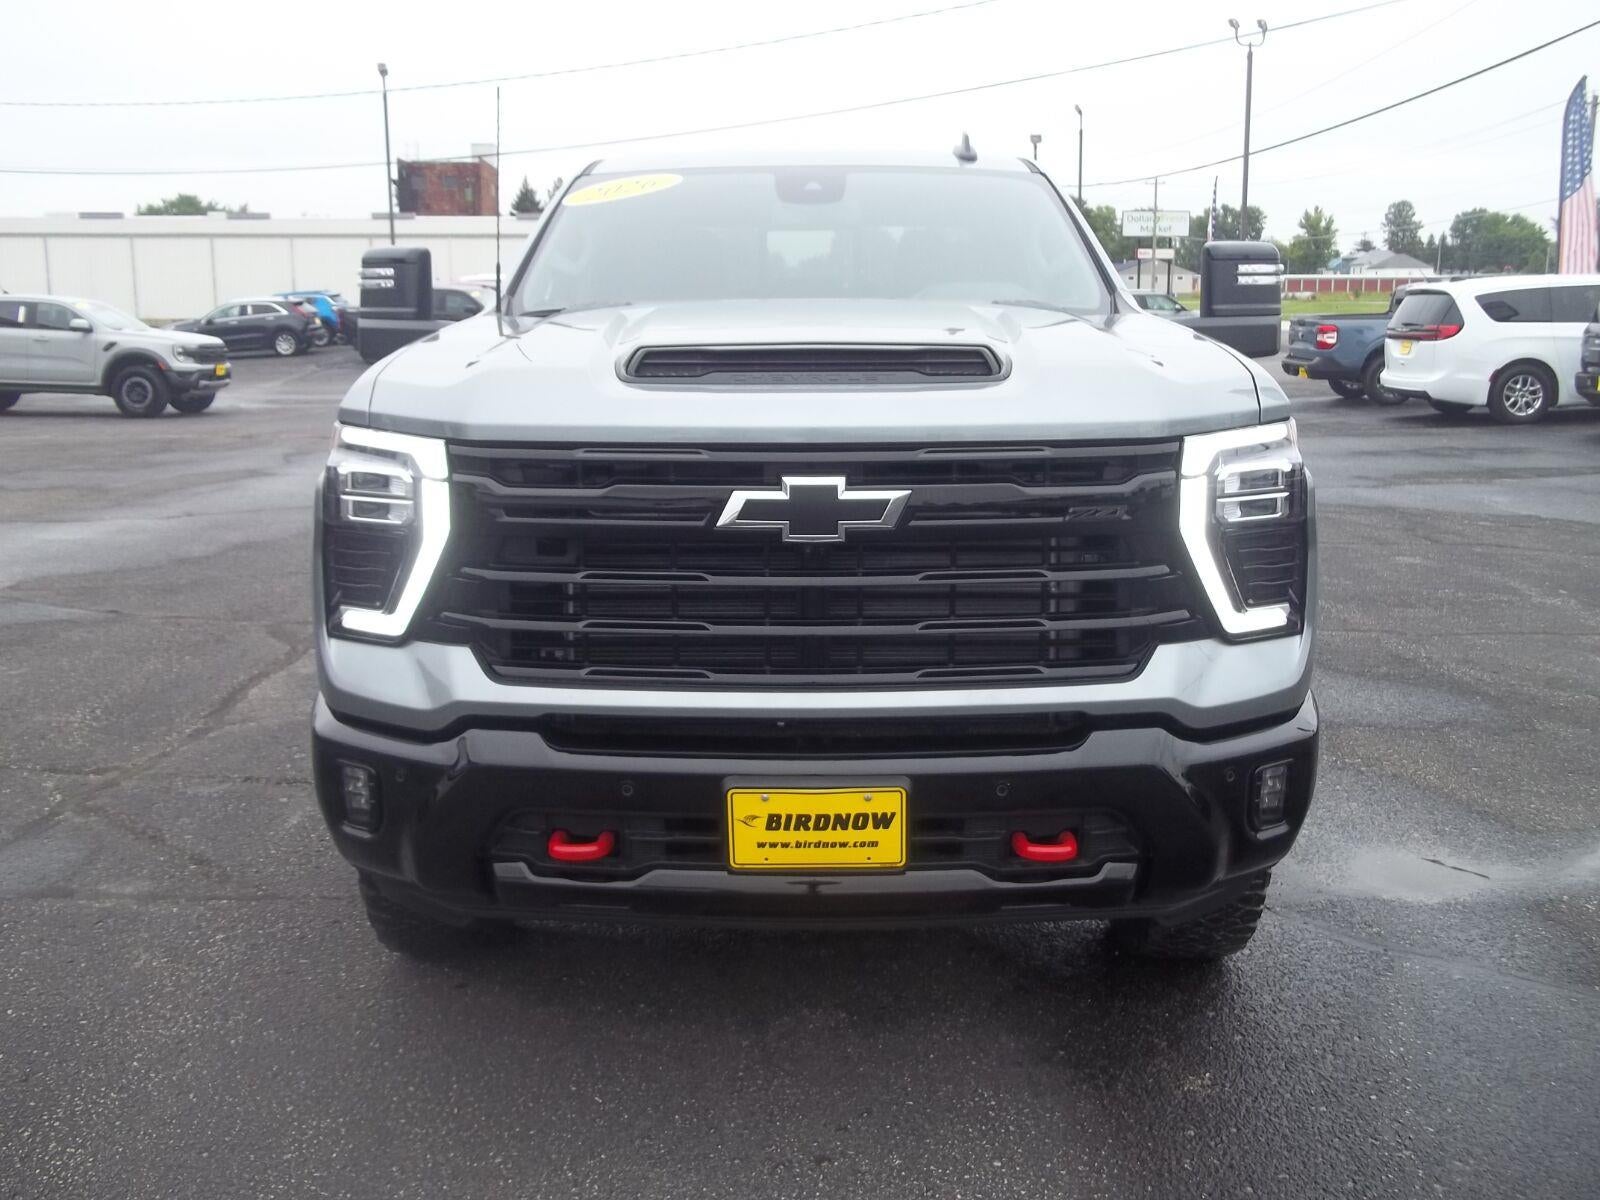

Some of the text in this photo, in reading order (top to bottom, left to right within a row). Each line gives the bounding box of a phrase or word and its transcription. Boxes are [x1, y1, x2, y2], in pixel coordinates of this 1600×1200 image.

[1140, 225, 1172, 233] Maket
[765, 811, 897, 832] BIRDNOW
[756, 839, 880, 849] www.birdnow.com
